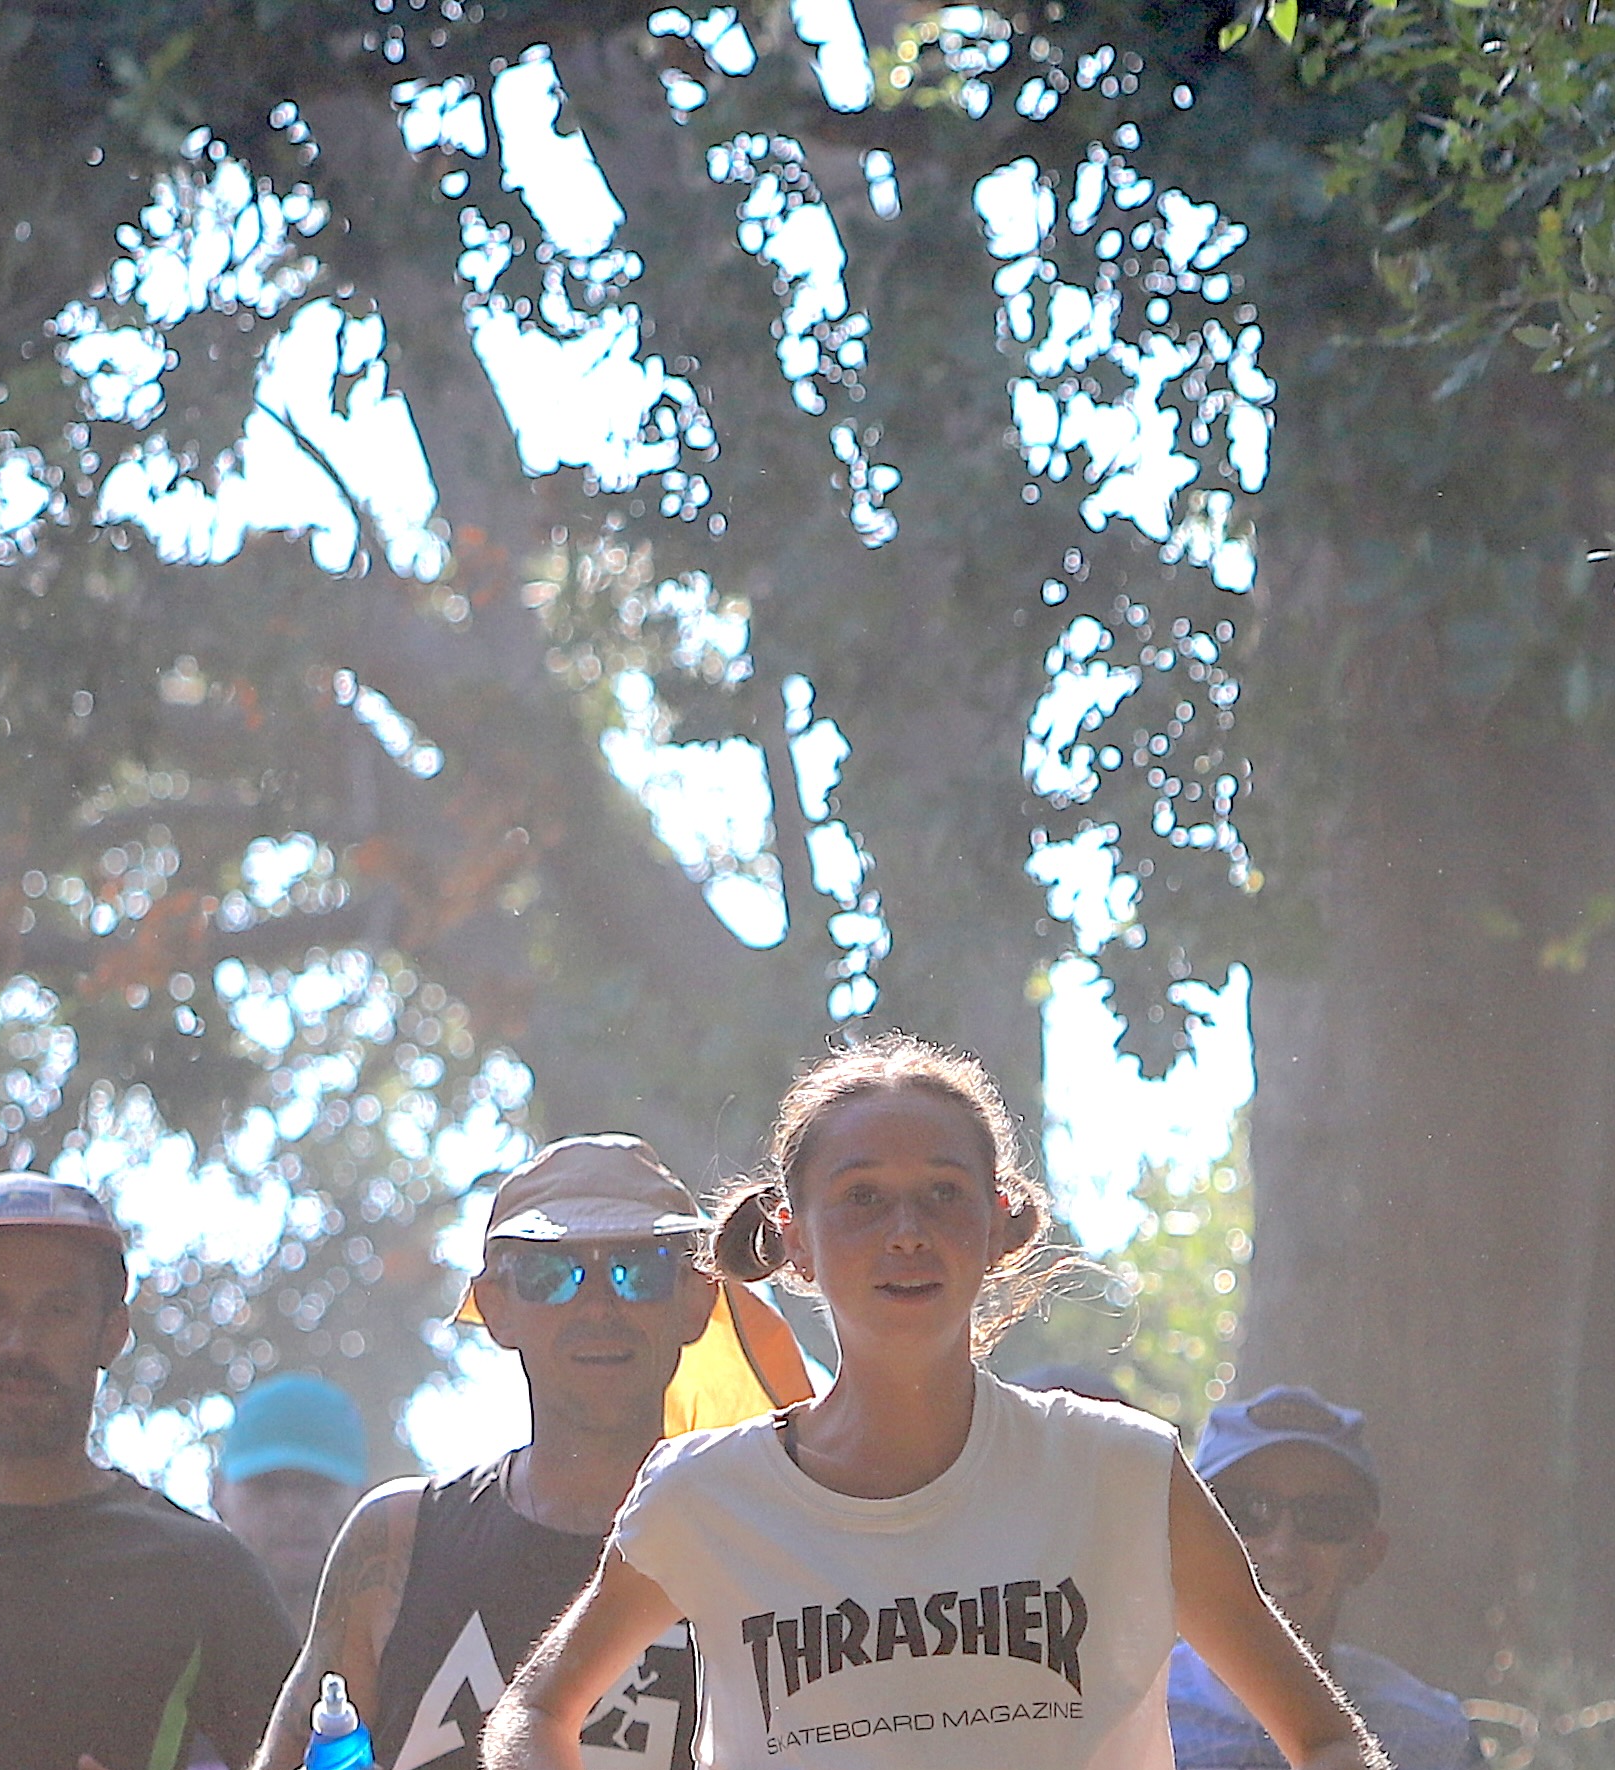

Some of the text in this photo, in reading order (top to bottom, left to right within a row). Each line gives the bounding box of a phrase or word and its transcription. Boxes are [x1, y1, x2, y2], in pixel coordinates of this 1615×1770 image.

[741, 1576, 1088, 1734] THRASHER
[766, 1701, 1084, 1756] SKATEBOARD MAGAZINE
